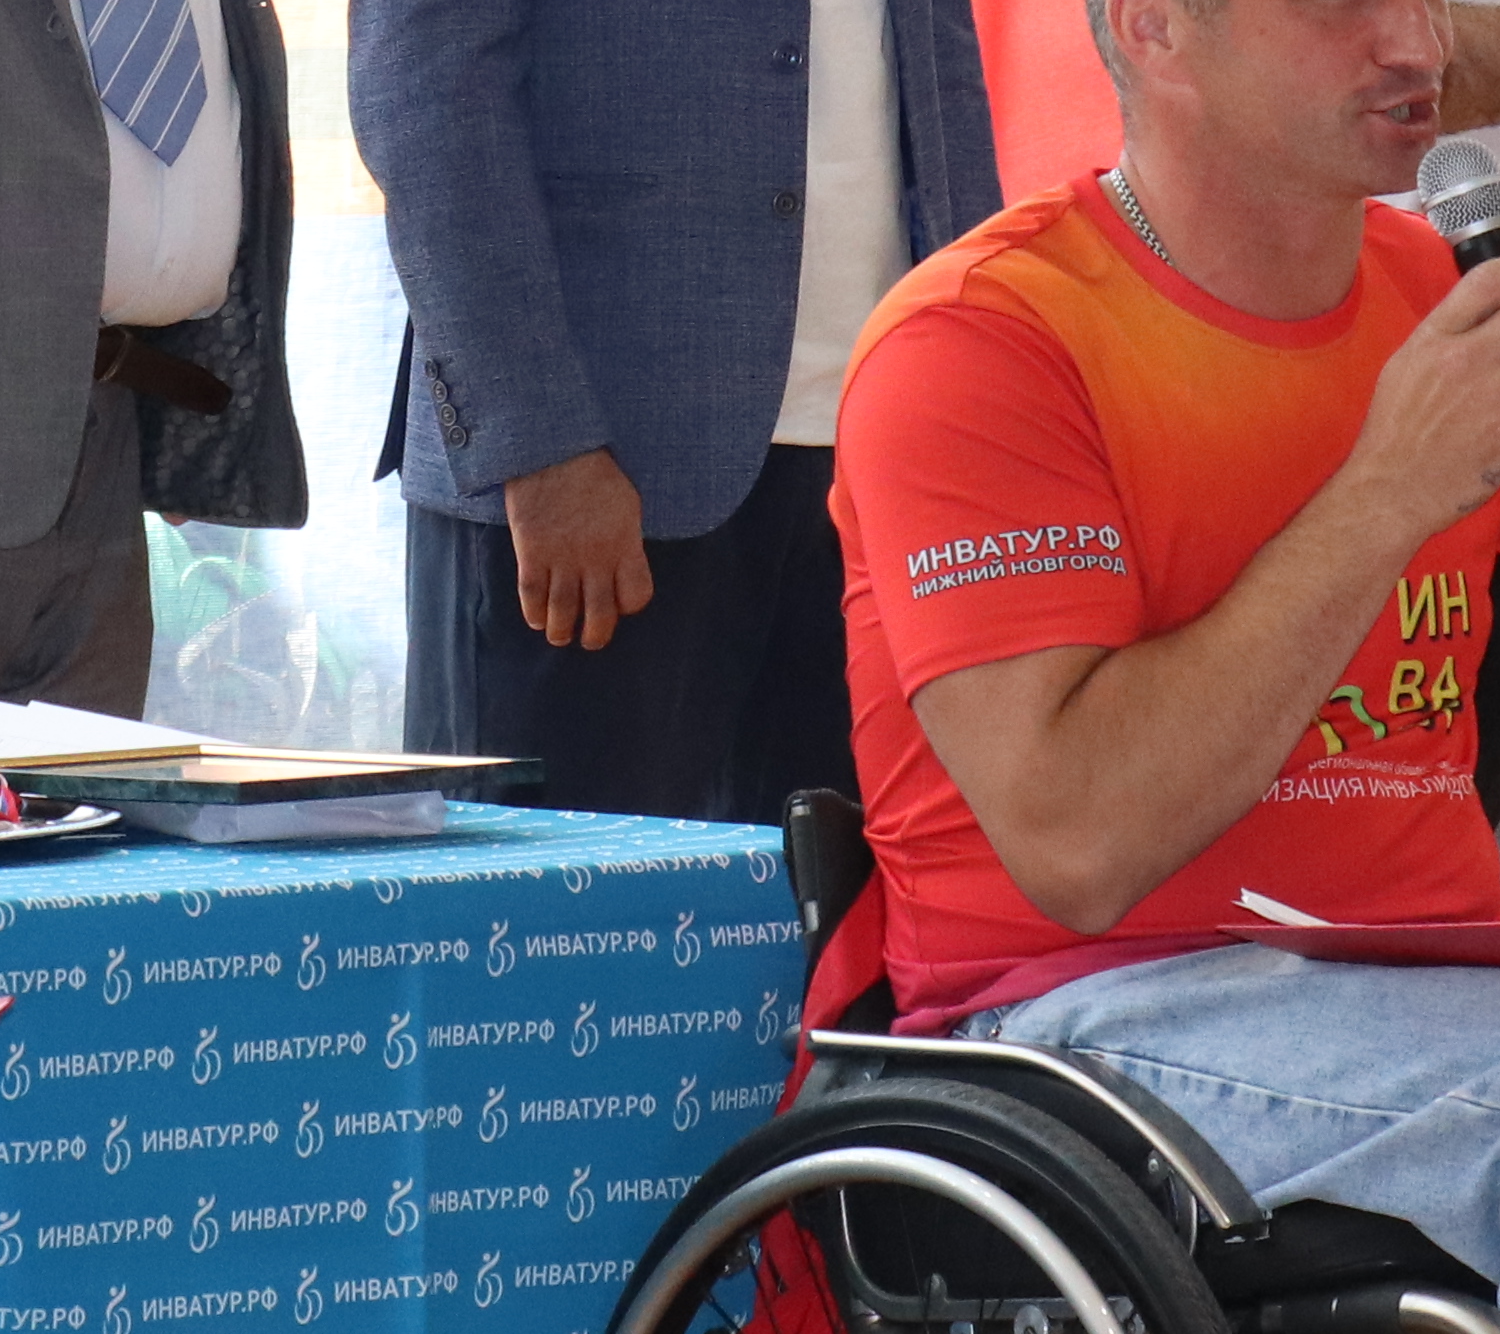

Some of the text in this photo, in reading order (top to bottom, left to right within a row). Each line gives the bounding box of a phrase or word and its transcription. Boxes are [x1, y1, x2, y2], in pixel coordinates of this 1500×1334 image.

[906, 525, 1122, 579] ИНВАТУР.РФ
[912, 554, 1127, 600] НИЖНИЙ НОВГОРОД
[1397, 571, 1469, 640] ИН
[337, 938, 470, 971] ИНВАТУР.РФ
[525, 929, 658, 958] ИНВАТУР.РФ
[143, 952, 283, 985] ИНВАТУР.РФ
[611, 1007, 743, 1038] ИНВАТУР.РФ
[39, 1046, 175, 1080] ИНВАТУР.РФ
[233, 1031, 368, 1065] ИНВАТУР.РФ
[519, 1092, 657, 1124] ИНВАТУР.РФ
[142, 1119, 280, 1154] ИНВАТУР.РФ
[37, 1214, 175, 1250] ИНВАТУР.РФ
[230, 1198, 368, 1233] ИНВАТУР.РФ
[142, 1286, 279, 1322] ИНВАТУР.РФ
